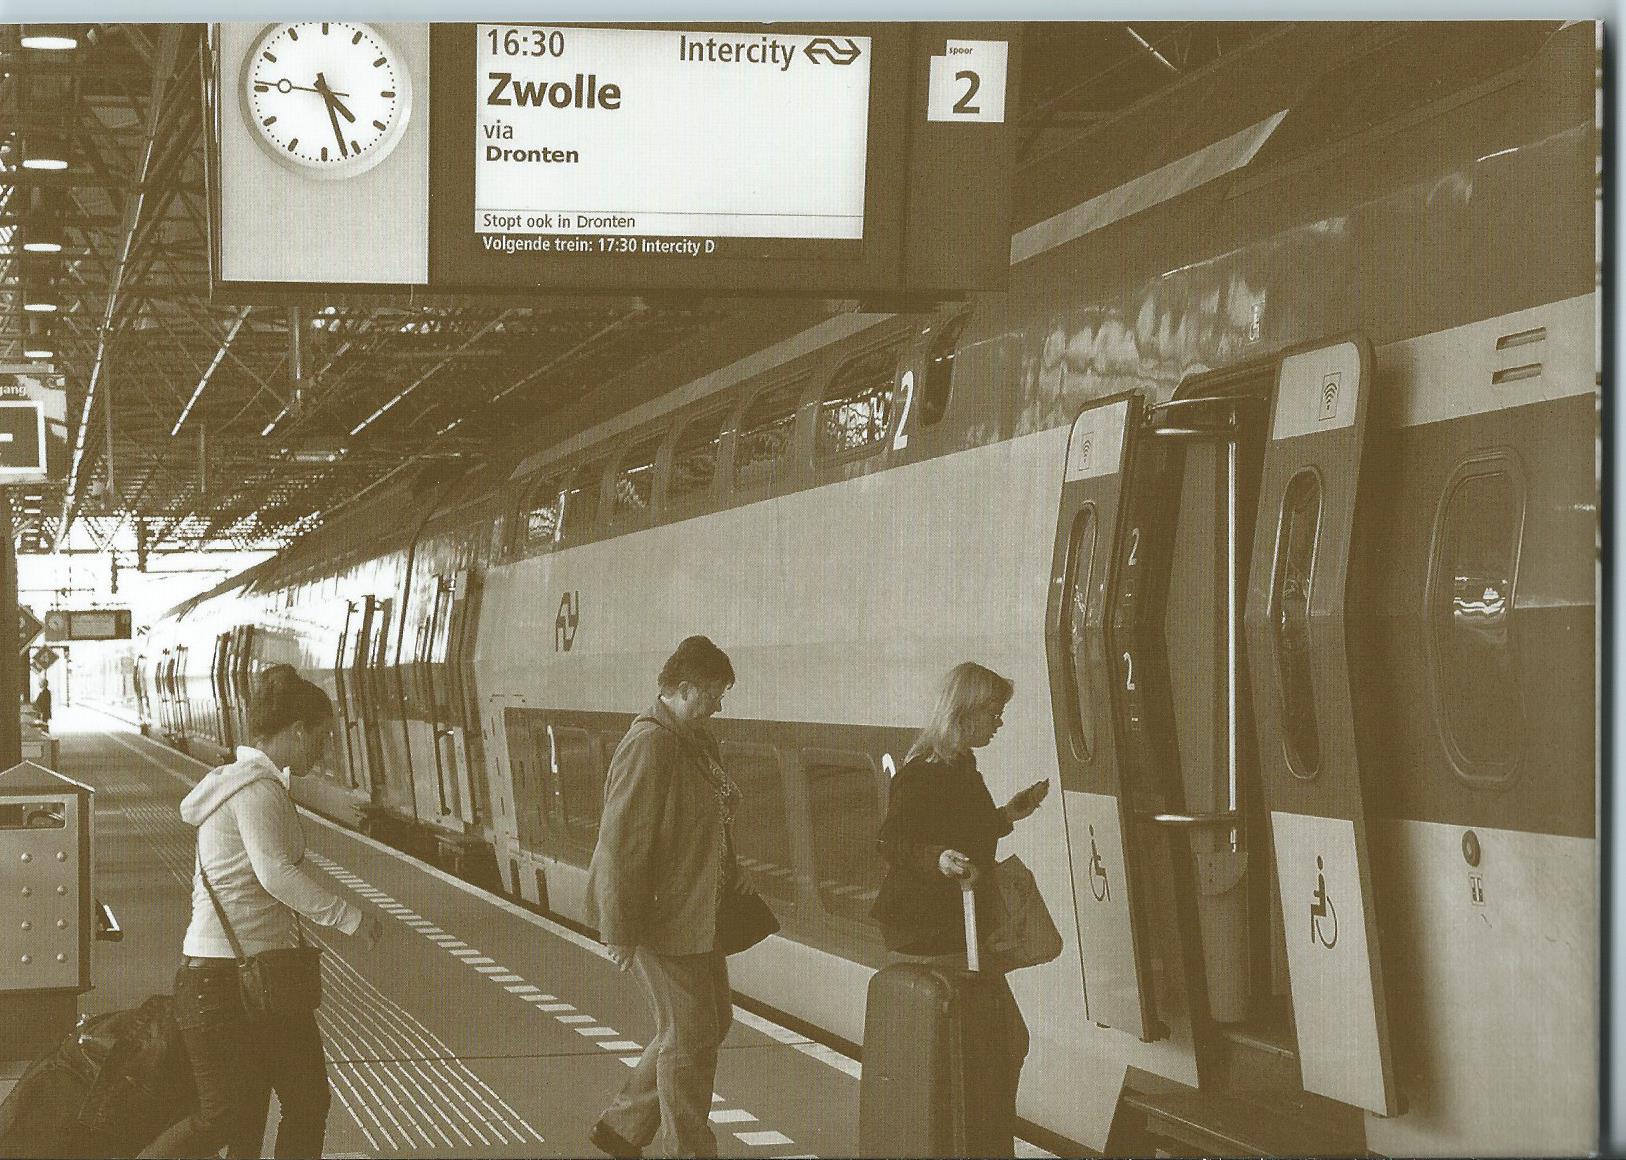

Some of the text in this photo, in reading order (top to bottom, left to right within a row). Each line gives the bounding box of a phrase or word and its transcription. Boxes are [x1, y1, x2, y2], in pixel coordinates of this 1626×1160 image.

[488, 29, 796, 71] 16:30 Intercity
[949, 47, 973, 55] spoor
[487, 72, 621, 110] Zwolle
[953, 70, 980, 114] 2
[483, 120, 513, 139] via
[486, 145, 579, 163] Dronten
[483, 213, 635, 230] Stopt ook in Dronten
[482, 235, 715, 256] Volgende trein: 17:30 Intercity D
[893, 370, 914, 450] 2
[1128, 528, 1140, 566] 2
[1123, 652, 1135, 691] 2
